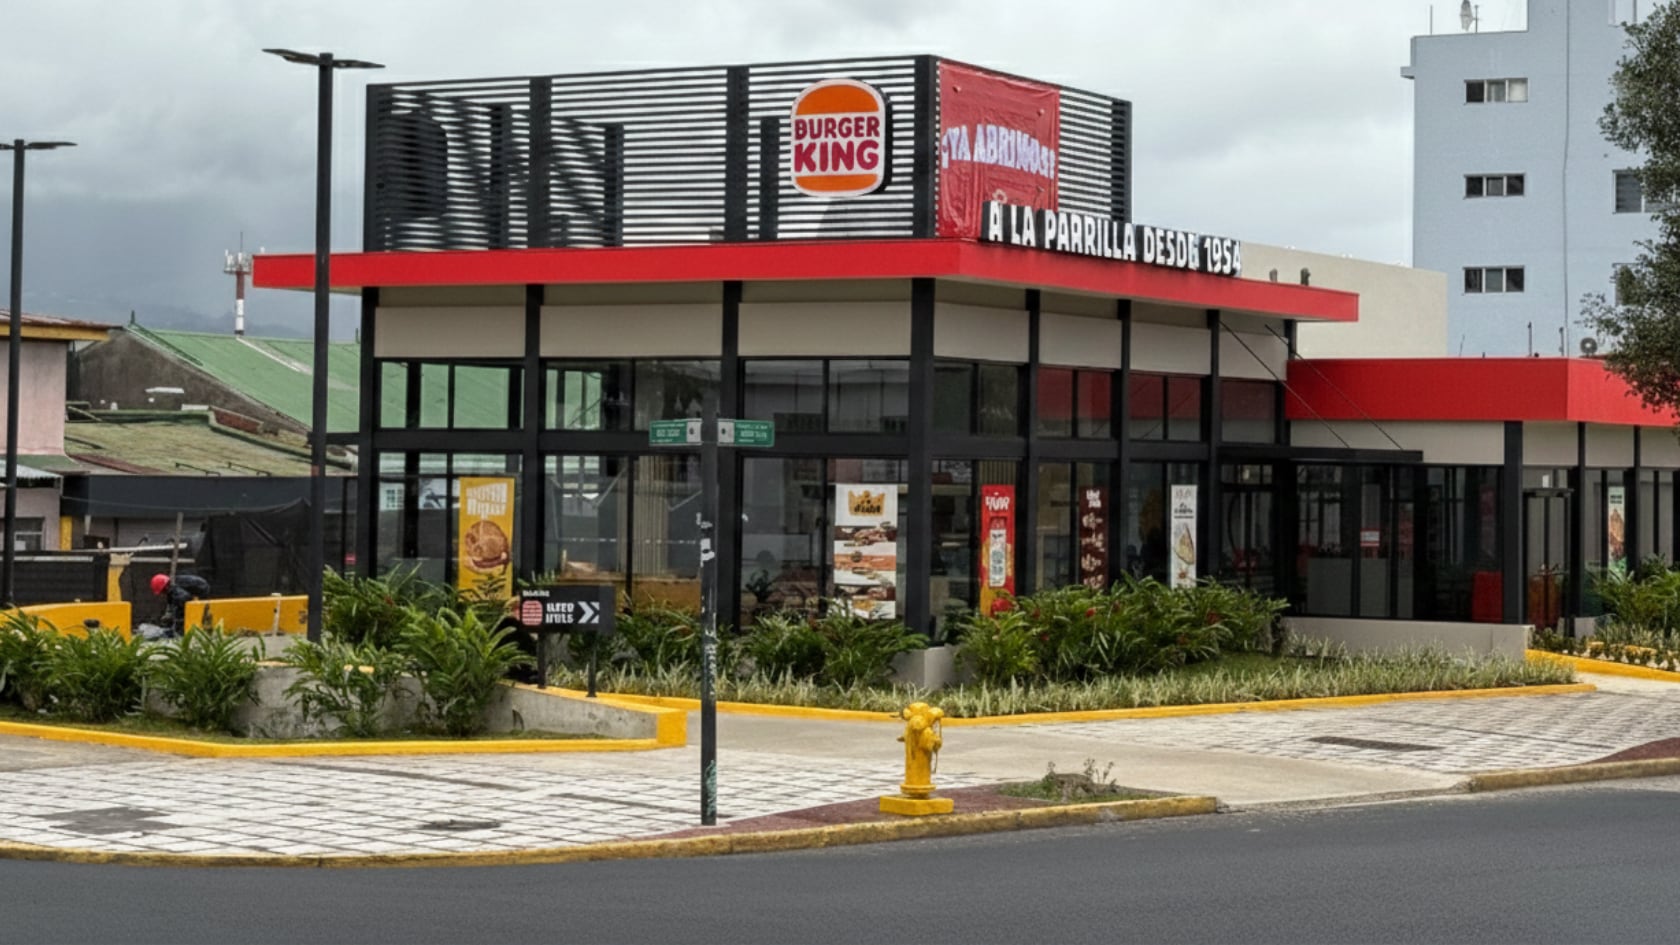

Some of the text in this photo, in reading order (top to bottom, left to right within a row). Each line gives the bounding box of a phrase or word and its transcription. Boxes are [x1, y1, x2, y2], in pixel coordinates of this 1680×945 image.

[794, 116, 880, 141] BURGER
[794, 139, 879, 173] KING
[988, 200, 1003, 242] A
[1011, 204, 1036, 247] LA
[1045, 208, 1137, 262] PARRILLA
